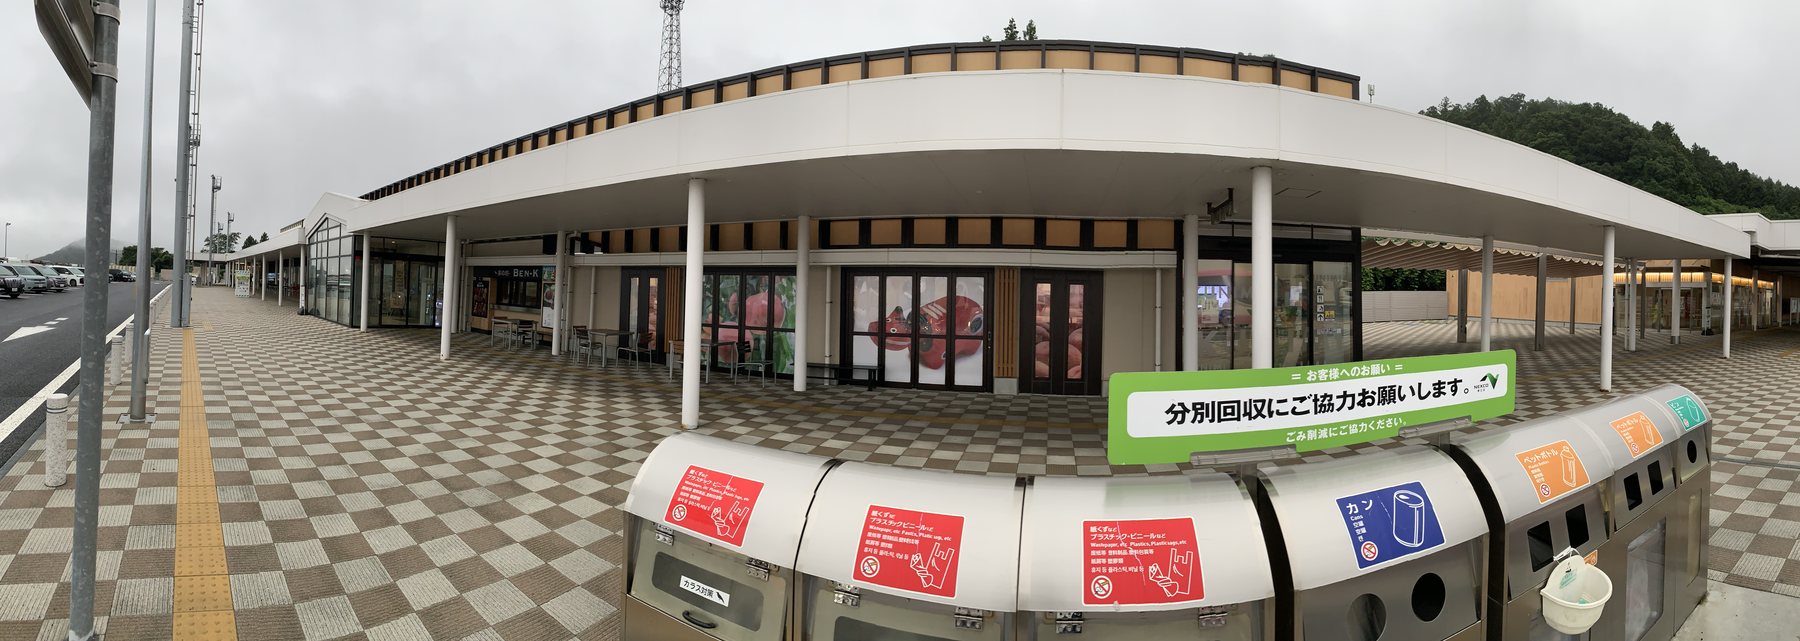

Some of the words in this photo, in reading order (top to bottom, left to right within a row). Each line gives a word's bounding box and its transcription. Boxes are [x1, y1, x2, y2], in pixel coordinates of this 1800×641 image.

[1306, 363, 1391, 382] お客様へのお願い
[1165, 378, 1469, 425] 分別回収にご協力お願いします。
[1286, 418, 1406, 442] ごみ削減にご協力ください。
[1524, 449, 1558, 463] ペットボトル
[1346, 500, 1372, 514] カン
[684, 580, 714, 598] カラス対策
